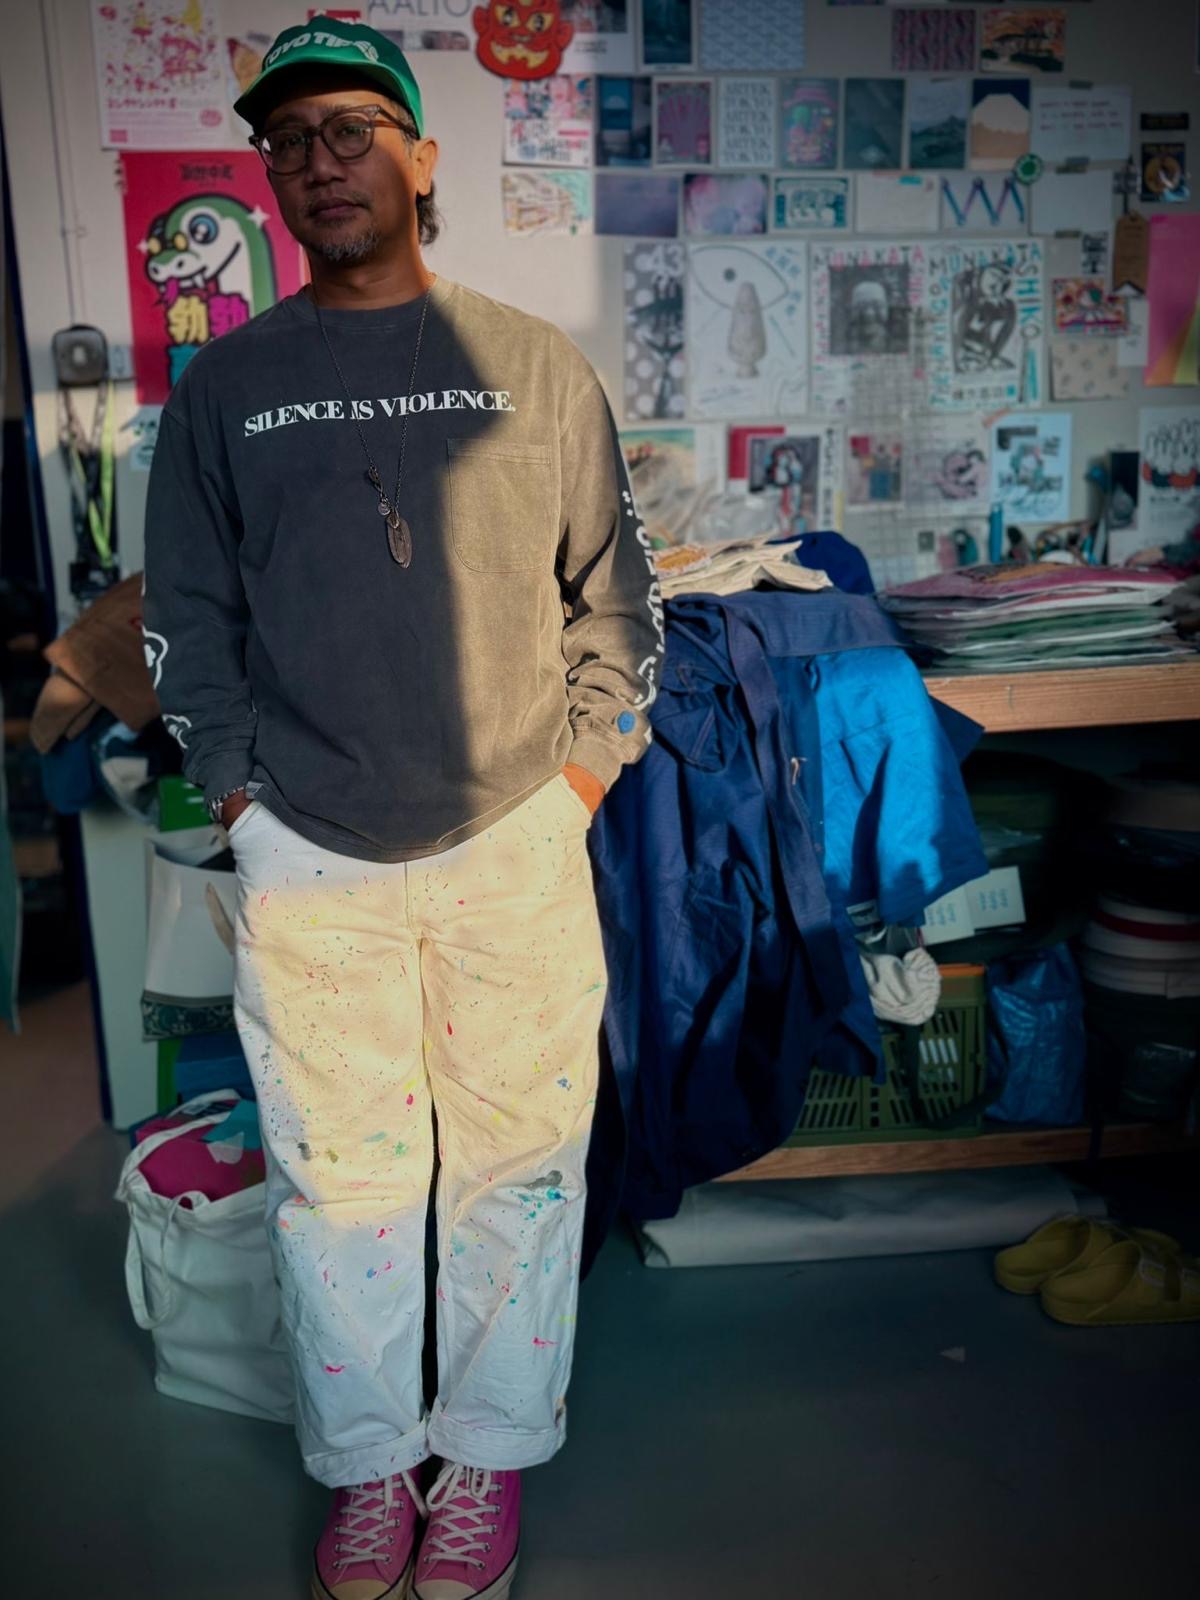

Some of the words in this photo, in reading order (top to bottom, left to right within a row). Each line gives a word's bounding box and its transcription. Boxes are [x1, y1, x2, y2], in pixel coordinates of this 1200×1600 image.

[244, 399, 344, 437] SILENCE
[350, 399, 374, 420] IS
[377, 389, 517, 417] VIOLENCE.
